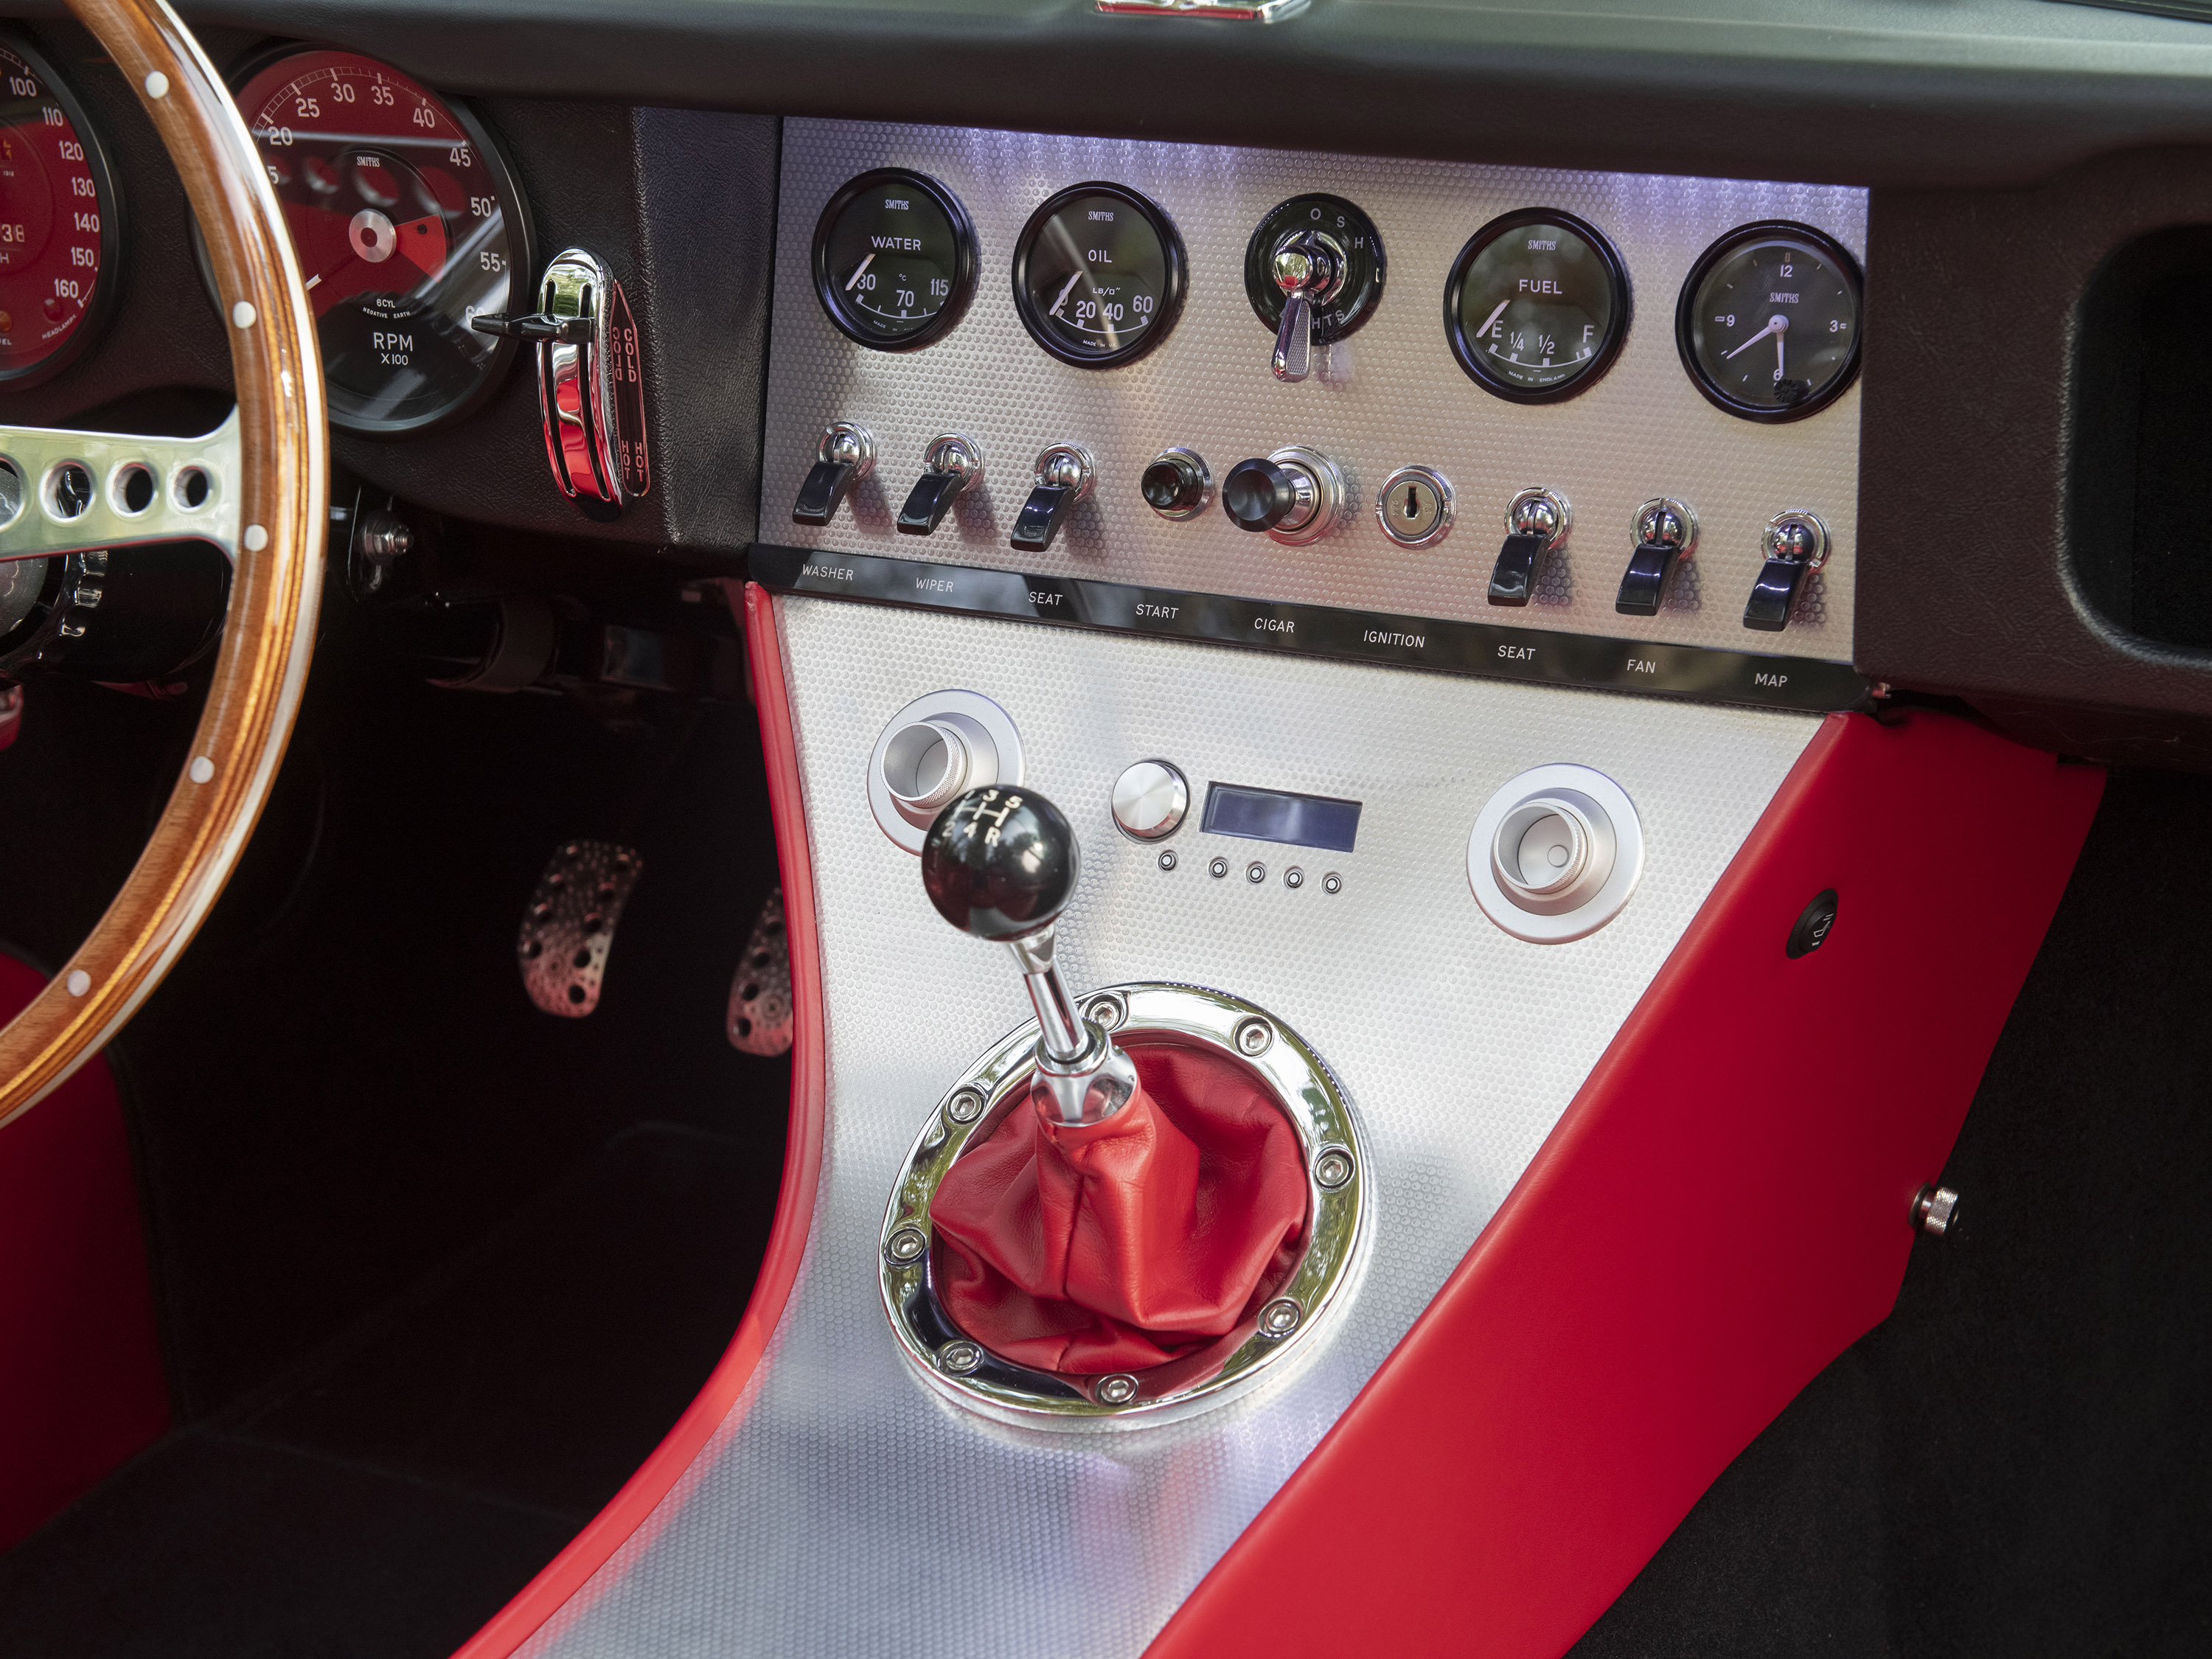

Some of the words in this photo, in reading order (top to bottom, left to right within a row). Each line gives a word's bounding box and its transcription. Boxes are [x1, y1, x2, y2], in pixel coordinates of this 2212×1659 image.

[10, 76, 37, 97] 100
[331, 83, 355, 103] 30
[371, 86, 394, 105] 35
[42, 106, 63, 127] 110
[295, 97, 320, 118] 25
[413, 108, 436, 128] 40
[268, 126, 293, 146] 20
[59, 141, 83, 161] 120
[449, 147, 471, 167] 45
[357, 156, 380, 167] SMITHS
[267, 164, 279, 184] 5
[72, 177, 96, 198] 130
[470, 197, 492, 218] 50
[885, 199, 909, 210] SMITHS
[74, 212, 100, 232] 140
[1088, 211, 1114, 222] SMITHS
[1336, 216, 1345, 228] S
[871, 235, 922, 251] WATER
[1354, 237, 1363, 249] H
[1528, 240, 1557, 251] SMITHS
[71, 247, 94, 268] 150
[480, 251, 501, 272] 55
[1088, 249, 1112, 262] OIL
[1780, 265, 1793, 277] 12
[54, 279, 79, 299] 160
[857, 274, 876, 291] 30
[931, 278, 949, 296] 115
[1519, 279, 1562, 294] FUEL
[896, 289, 915, 307] 70
[1133, 295, 1153, 313] 60
[1770, 292, 1799, 304] SMITHS
[362, 307, 389, 319] NEGATIVE
[393, 310, 411, 319] EARTH
[1076, 300, 1096, 319] 20
[1102, 302, 1124, 321] 40
[873, 320, 886, 329] MADE
[1492, 320, 1503, 338] E
[1727, 314, 1736, 327] 9
[1829, 320, 1838, 333] 3
[0, 338, 13, 346] EL
[373, 332, 413, 352] RPM
[1583, 324, 1594, 343] F
[624, 328, 637, 383] COLD
[1509, 370, 1523, 380] MADE
[1539, 373, 1565, 383] ENGLAND
[1773, 369, 1782, 381] 6
[635, 442, 644, 482] HOT
[801, 564, 854, 581] WASHER
[916, 577, 953, 593] WIPER
[1028, 591, 1063, 607] SEAT
[1135, 604, 1179, 619] START
[1254, 618, 1295, 633] CIGAR
[1363, 630, 1425, 649] IGNITION
[1498, 645, 1536, 661] SEAT
[1627, 658, 1656, 674] FAN
[1755, 672, 1788, 688] MAP
[983, 789, 999, 801] 3
[942, 820, 956, 838] 2
[963, 821, 978, 838] 4
[984, 826, 1001, 847] R
